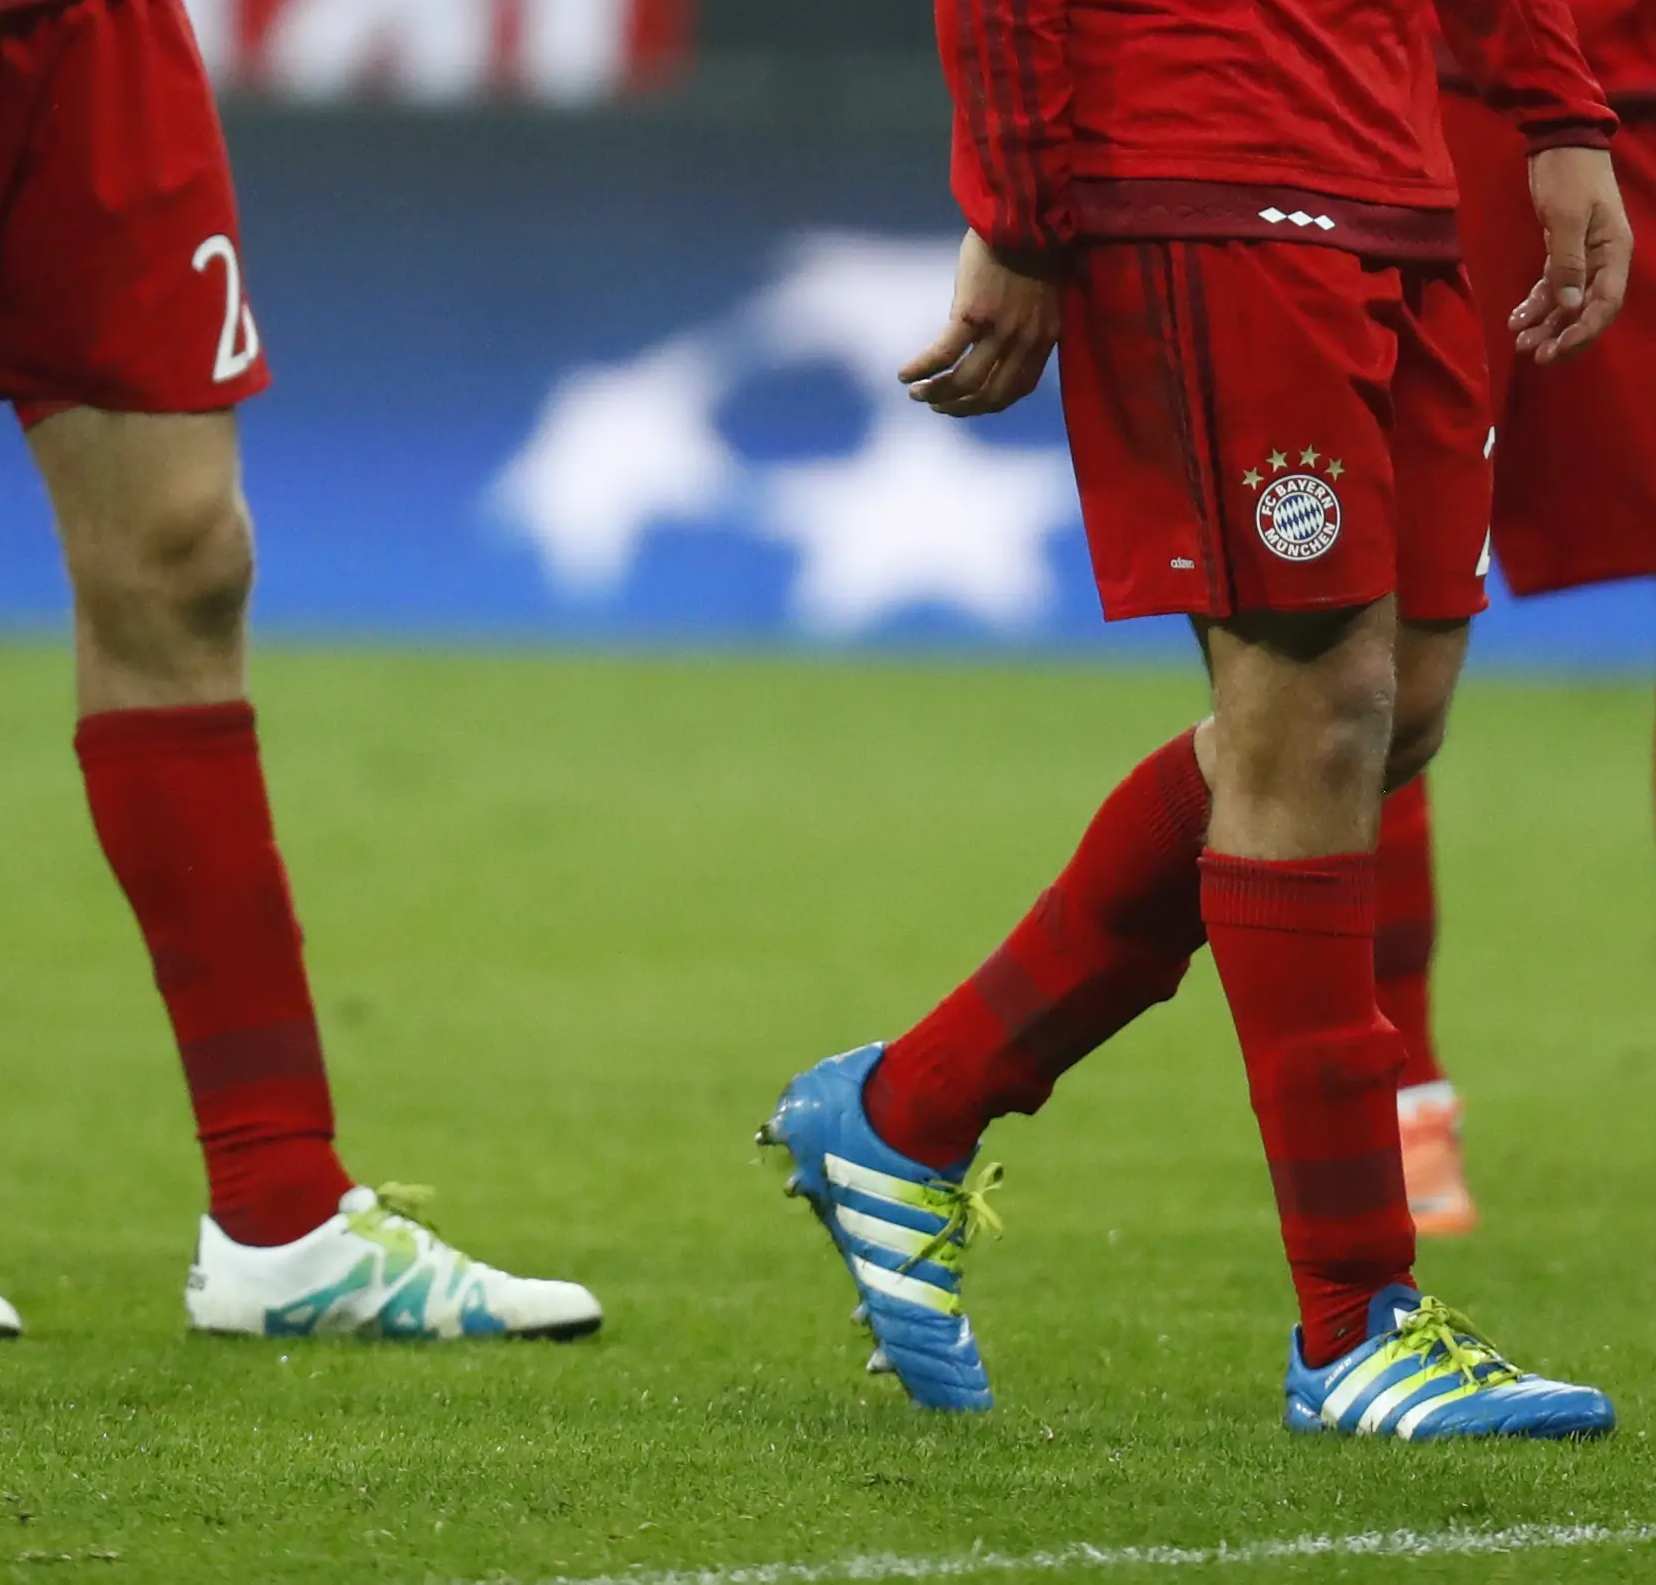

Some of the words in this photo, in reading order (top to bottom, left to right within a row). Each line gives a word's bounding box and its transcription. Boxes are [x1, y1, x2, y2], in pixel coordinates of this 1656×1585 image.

[192, 233, 260, 384] 2
[1262, 495, 1275, 515] FC
[1275, 480, 1334, 509] BAYERN
